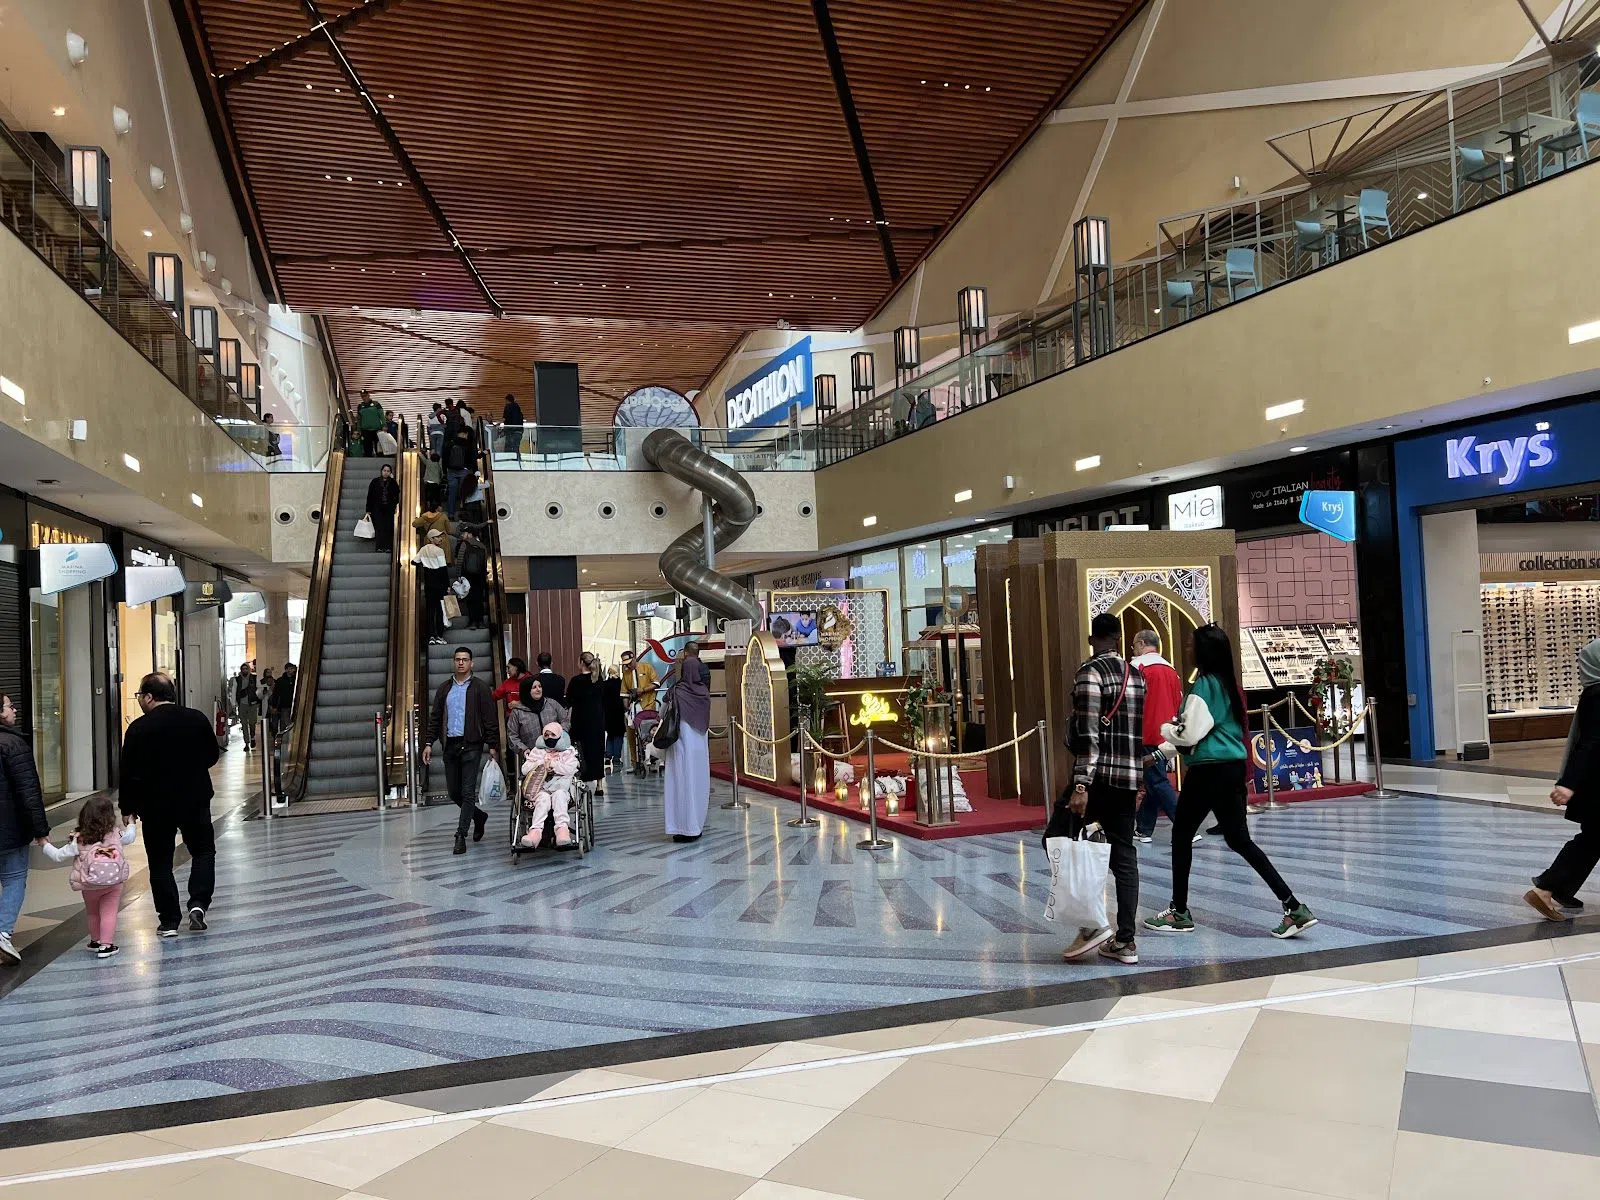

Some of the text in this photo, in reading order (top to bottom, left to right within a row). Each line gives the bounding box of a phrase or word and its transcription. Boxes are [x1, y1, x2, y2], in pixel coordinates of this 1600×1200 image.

[727, 355, 805, 430] DECATHLON
[1446, 433, 1553, 485] Krys
[1250, 489, 1271, 499] your
[1272, 481, 1309, 495] ITALIAN
[1274, 498, 1288, 506] Italy
[1321, 501, 1342, 514] Krys
[1519, 555, 1586, 571] collection
